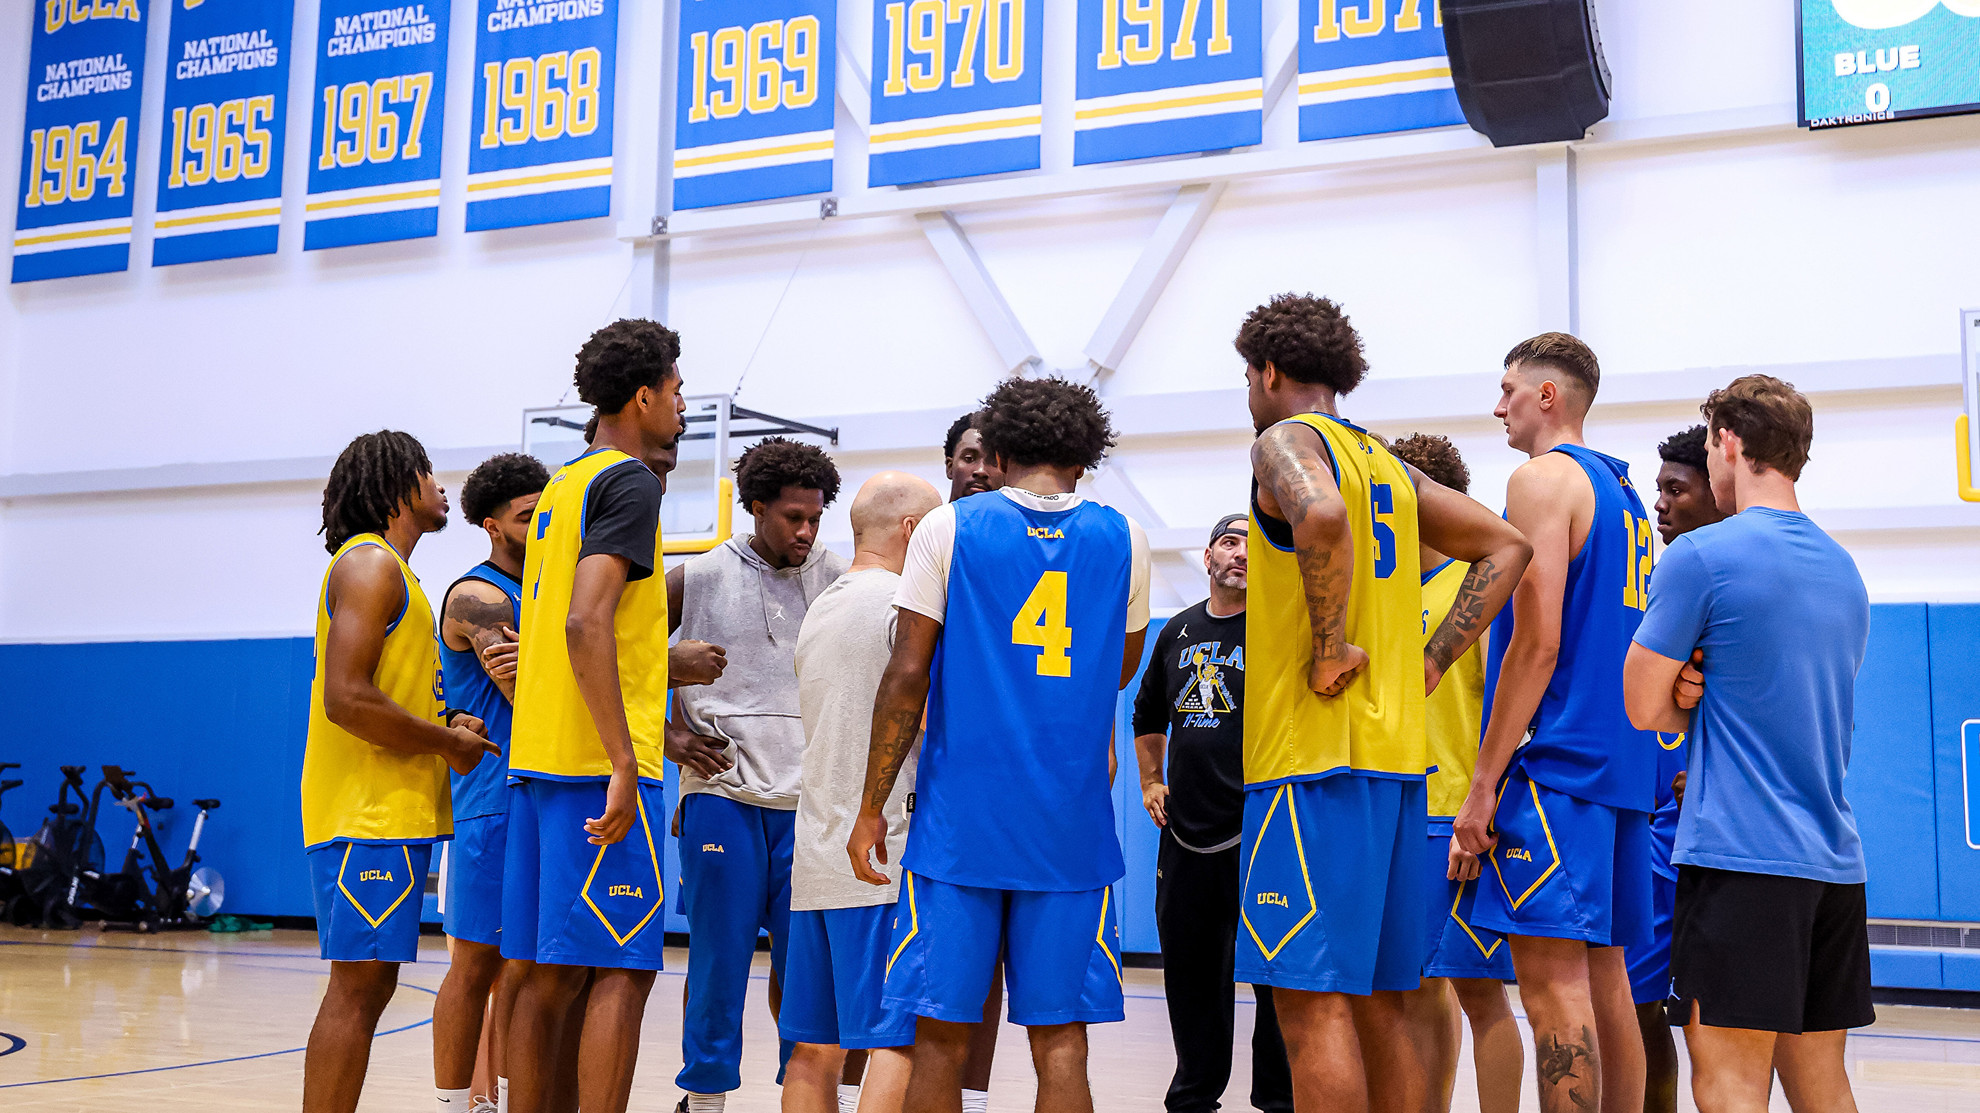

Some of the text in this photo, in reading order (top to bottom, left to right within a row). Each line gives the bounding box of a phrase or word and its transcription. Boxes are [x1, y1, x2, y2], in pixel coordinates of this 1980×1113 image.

[334, 4, 430, 36] NATIONAL
[487, 0, 604, 33] CHAMPIONS
[183, 29, 273, 60] NATIONAL
[327, 23, 436, 57] CHAMPIONS
[884, 0, 1025, 97] 1970
[1097, 0, 1232, 70] 1971
[45, 54, 128, 83] NATIONAL
[176, 48, 278, 80] CHAMPIONS
[688, 15, 820, 124] 1969
[1834, 45, 1921, 77] BLUE
[37, 71, 132, 102] CHAMPIONS
[480, 47, 601, 150] 1968
[1865, 83, 1891, 113] 0
[318, 72, 433, 171] 1967
[1810, 111, 1895, 127] DAKTRONICS
[168, 95, 275, 189] 1965
[25, 117, 128, 208] 1964
[1026, 525, 1065, 540] UCLA
[1369, 478, 1397, 579] 5
[1623, 509, 1654, 612] 12
[1011, 570, 1072, 678] 4
[1178, 641, 1245, 671] UCLA
[1182, 712, 1221, 729] 11-Time
[702, 843, 725, 853] UCLA
[1505, 847, 1533, 863] UCLA
[359, 869, 394, 882] UCLA
[608, 884, 644, 899] UCLA
[1257, 892, 1289, 908] UCLA
